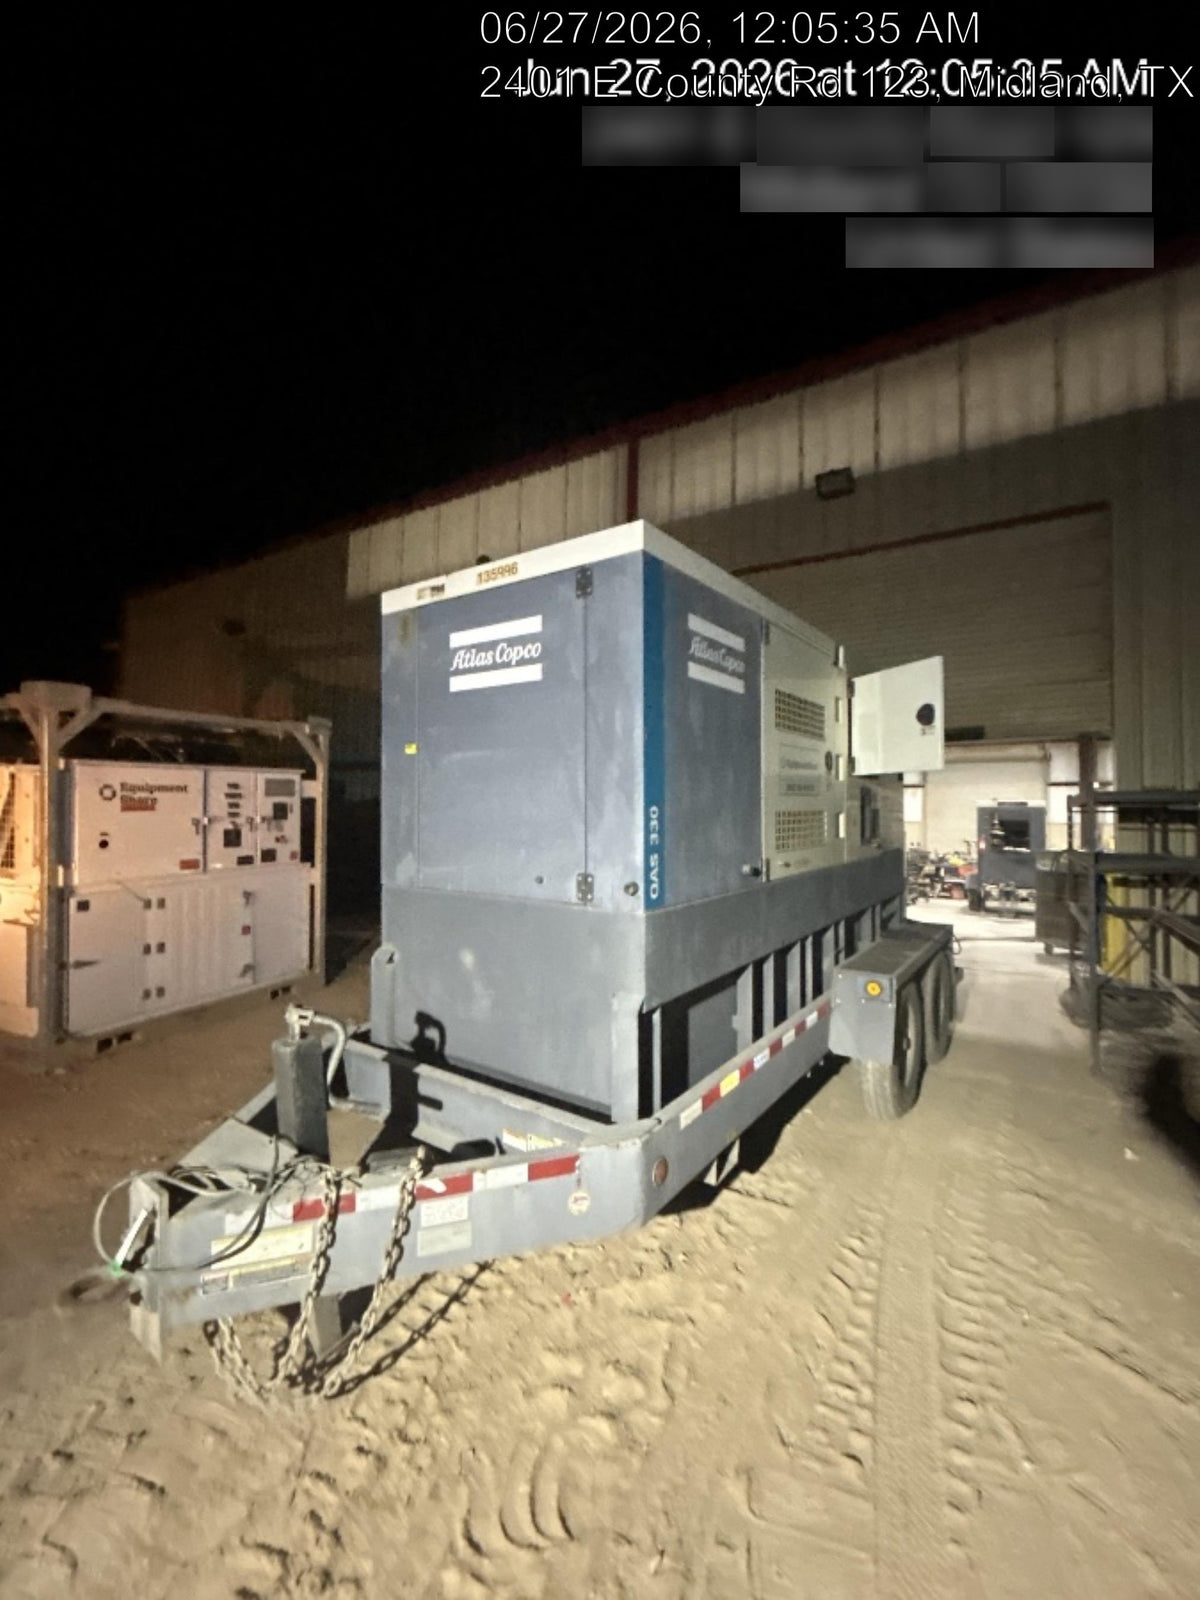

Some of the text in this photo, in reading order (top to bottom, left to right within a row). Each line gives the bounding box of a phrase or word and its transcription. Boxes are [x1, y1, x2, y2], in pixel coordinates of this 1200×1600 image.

[450, 642, 542, 671] Atlas Copco
[650, 805, 659, 846] 330
